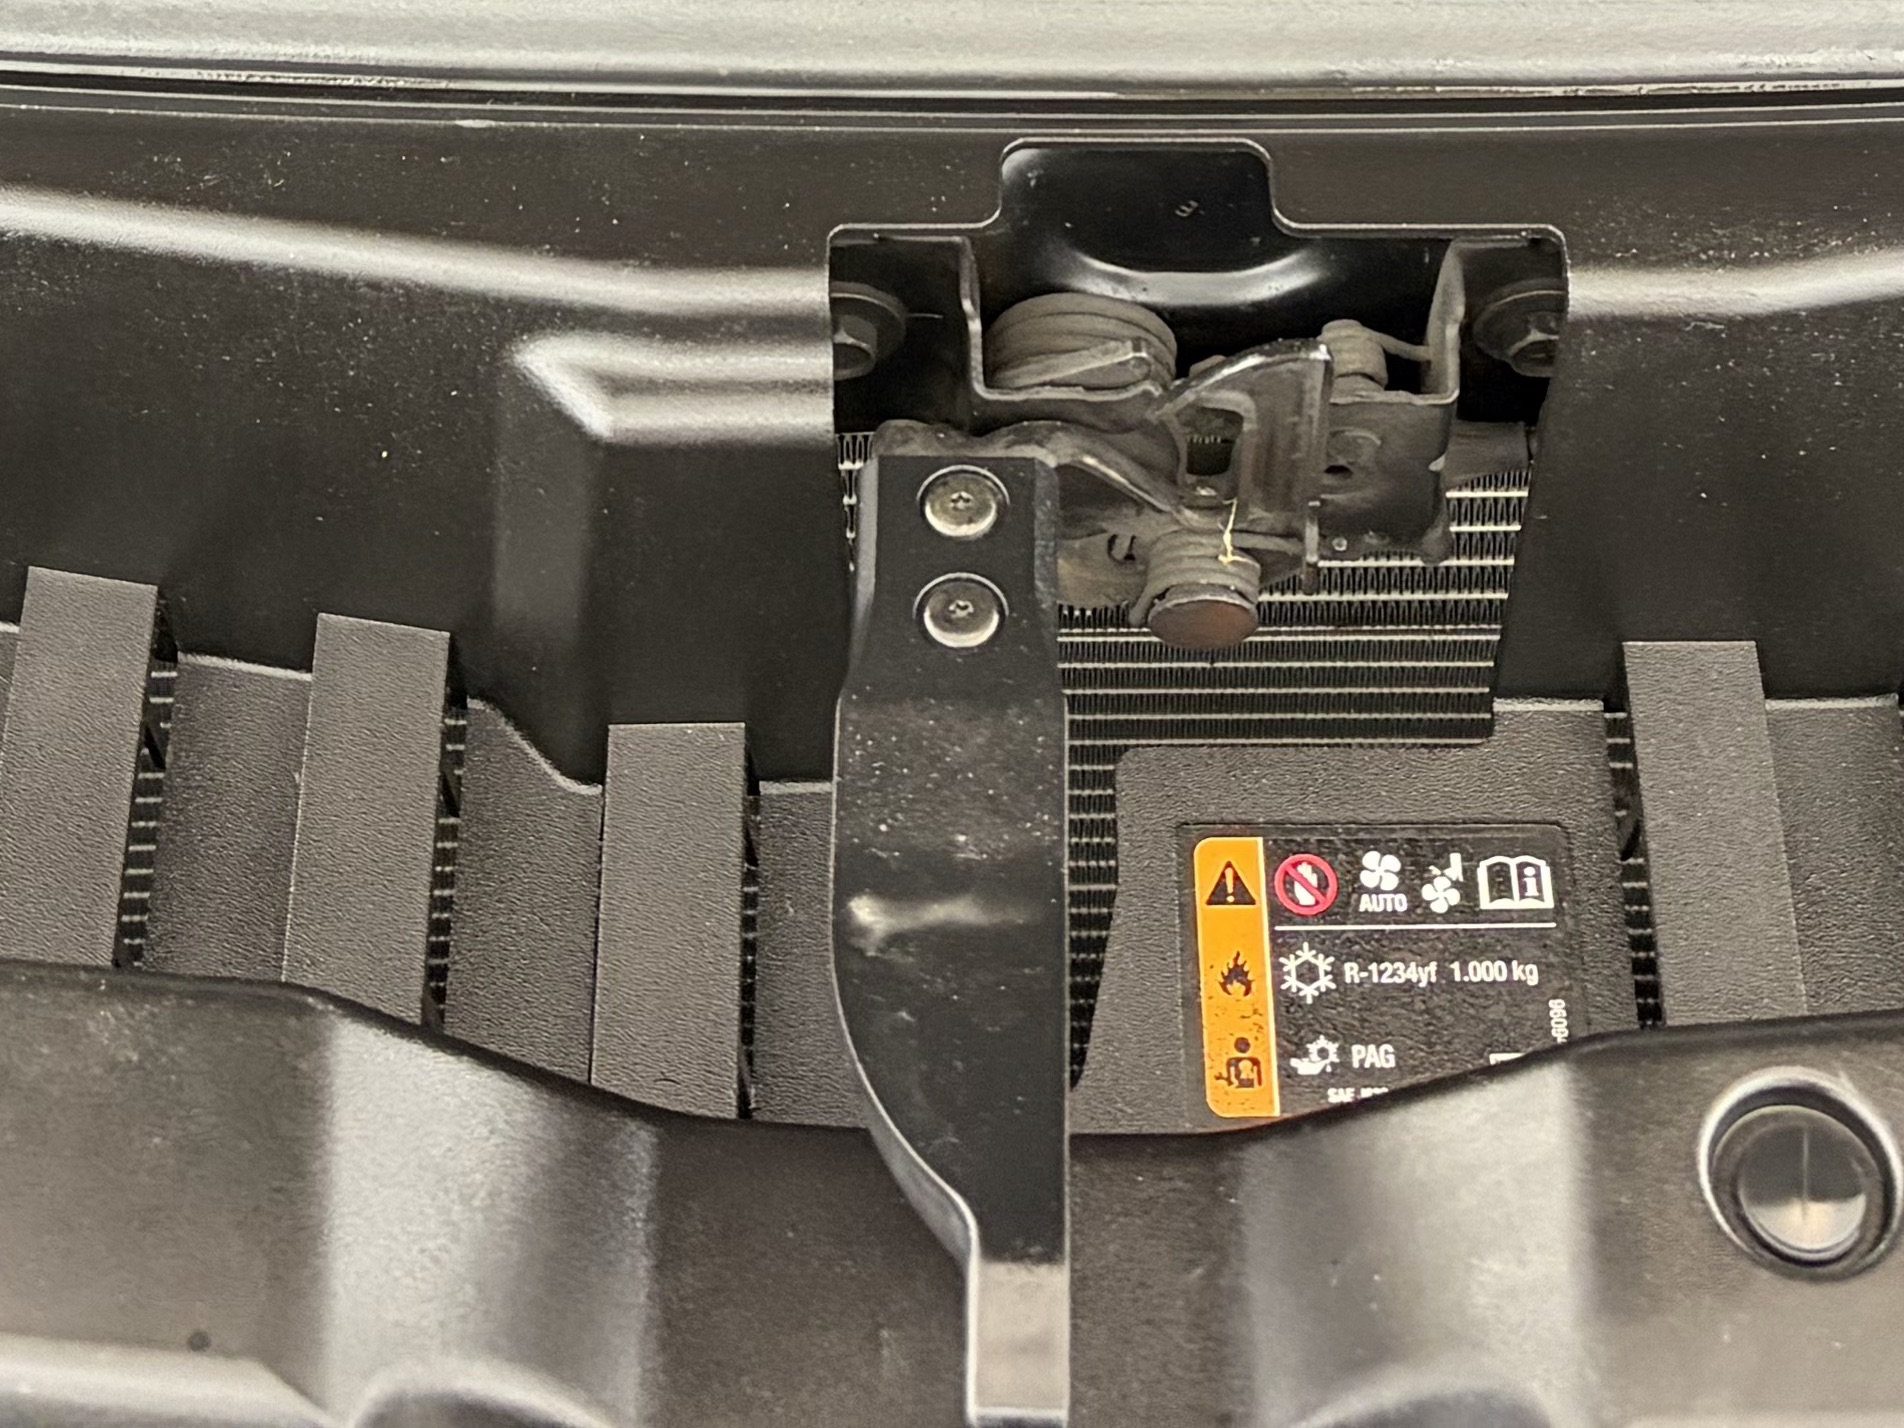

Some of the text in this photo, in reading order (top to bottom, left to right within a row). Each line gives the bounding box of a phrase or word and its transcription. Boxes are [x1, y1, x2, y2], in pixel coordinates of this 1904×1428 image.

[1359, 893, 1408, 913] AUTO
[1343, 959, 1540, 988] R-1234yf 1.000 kg
[1351, 1043, 1396, 1069] PAG
